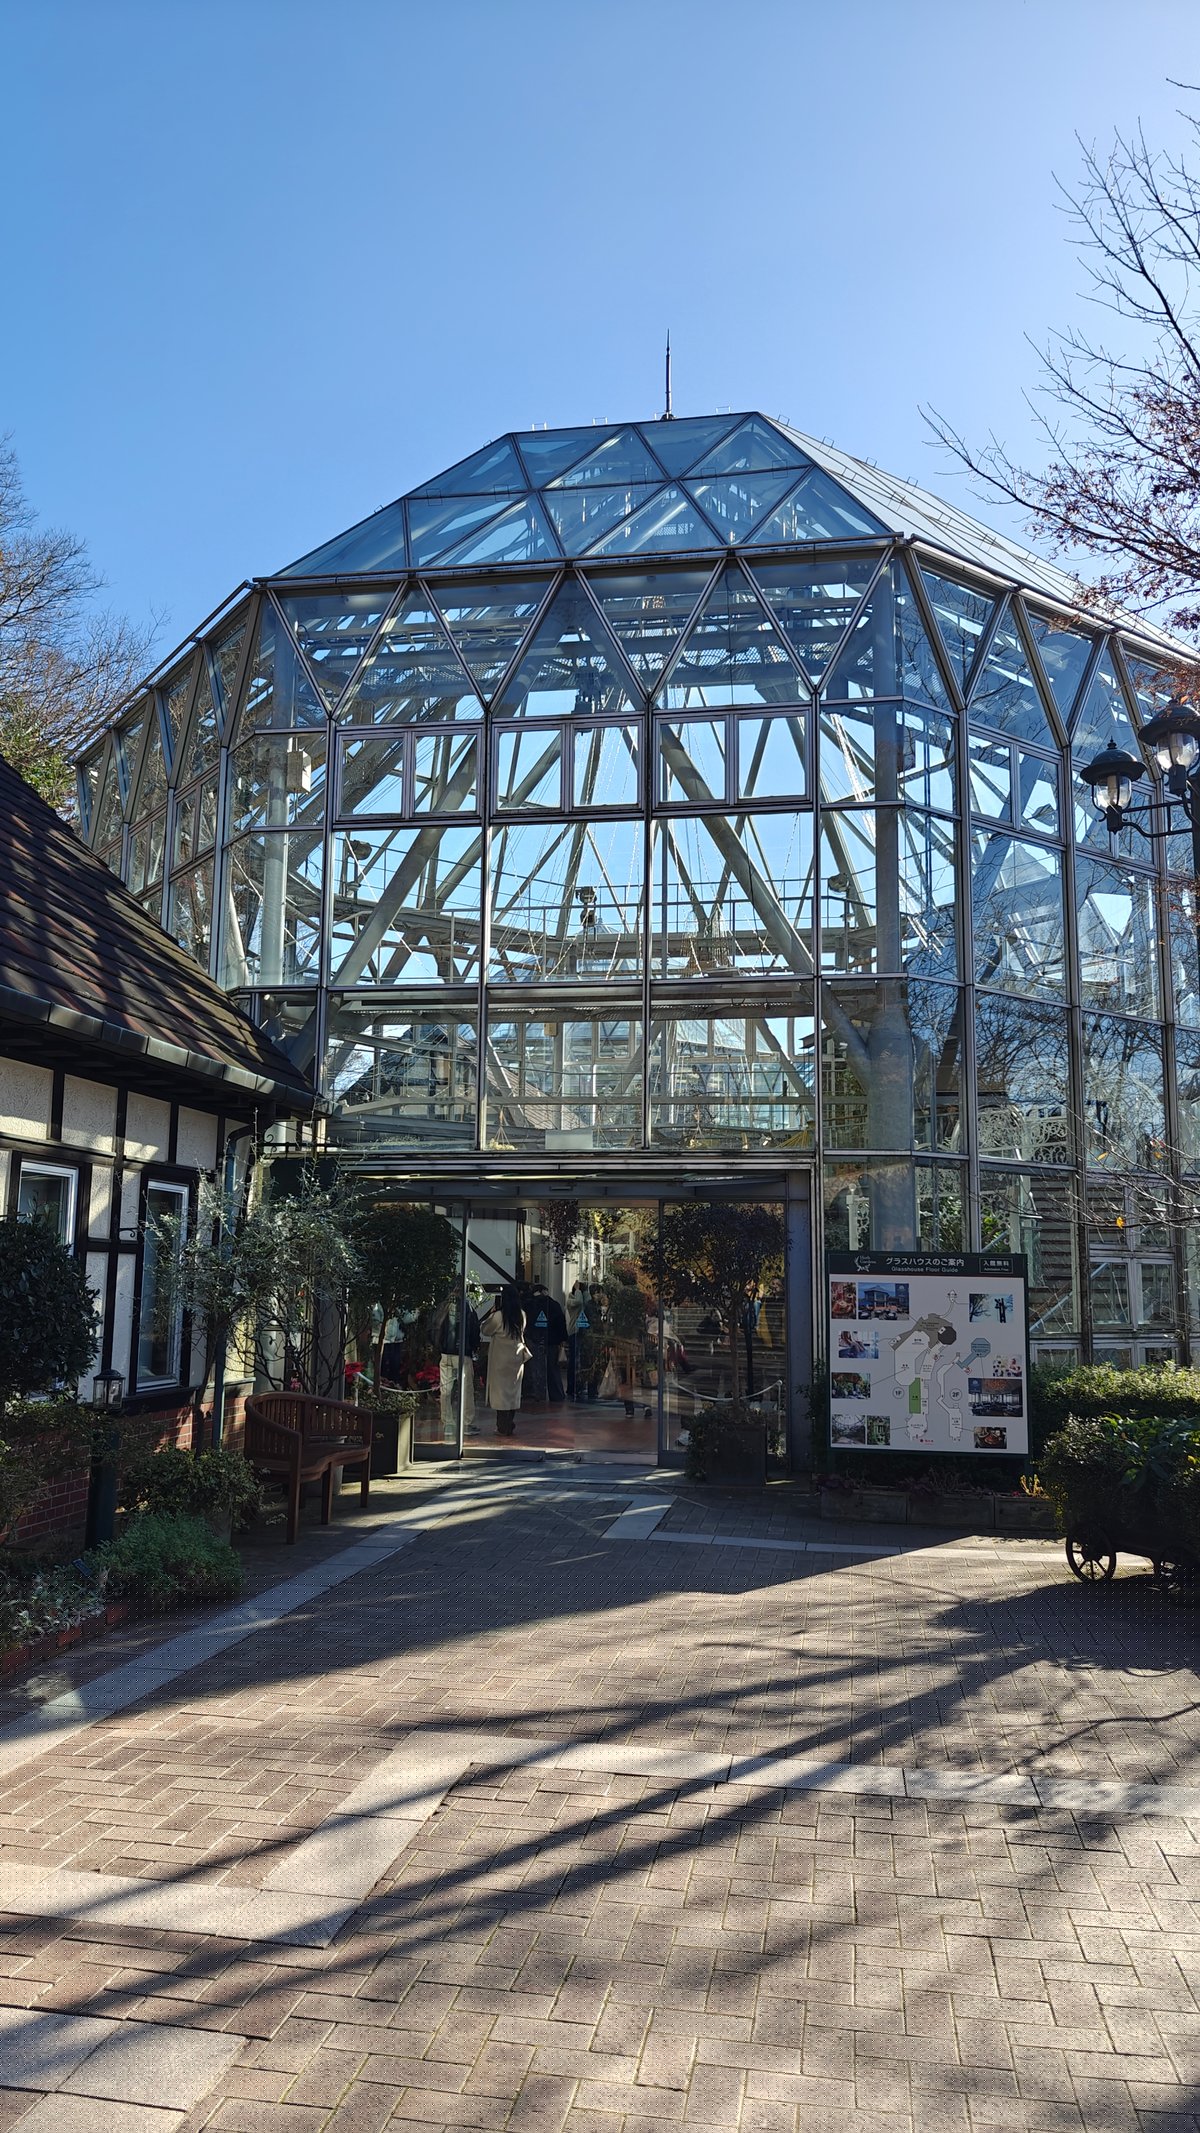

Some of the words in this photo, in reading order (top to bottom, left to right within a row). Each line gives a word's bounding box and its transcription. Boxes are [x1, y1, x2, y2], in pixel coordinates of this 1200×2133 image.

[886, 1257, 965, 1267] グラスハウスのご案内
